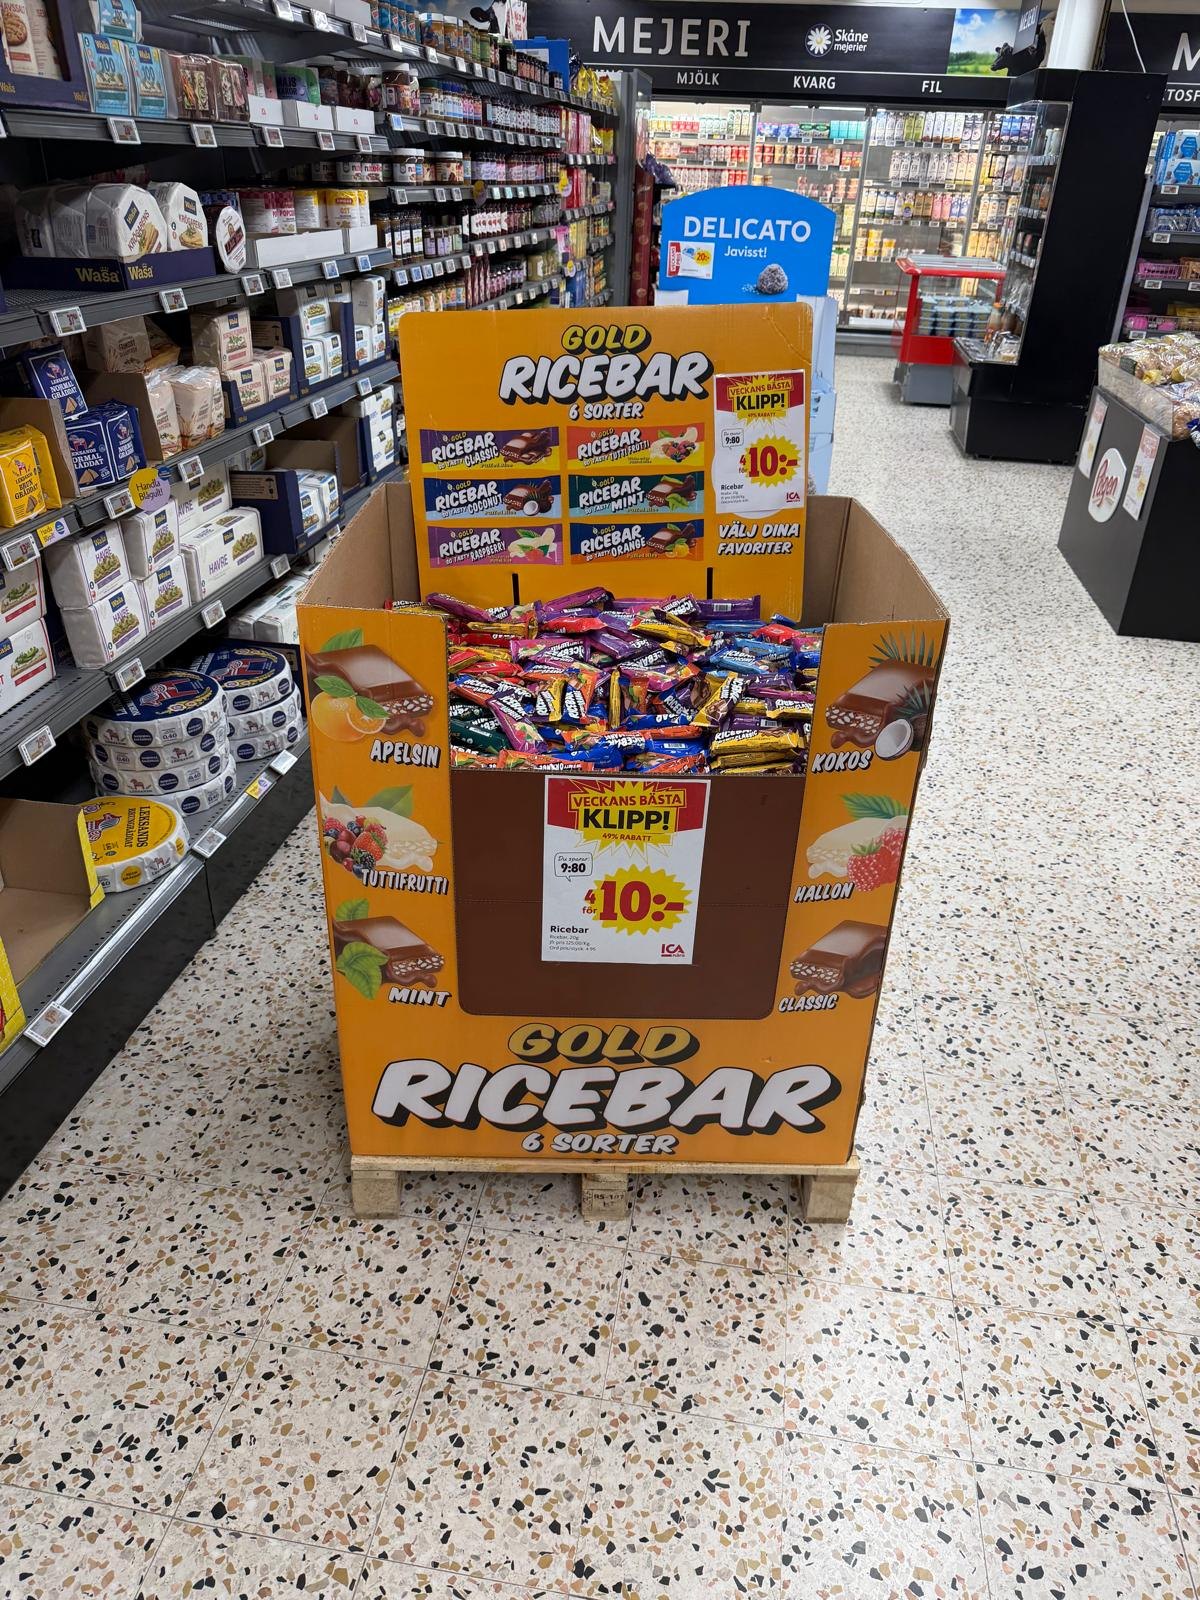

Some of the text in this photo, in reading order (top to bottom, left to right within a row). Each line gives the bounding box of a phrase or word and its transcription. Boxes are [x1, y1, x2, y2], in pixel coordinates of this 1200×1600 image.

[593, 16, 751, 57] MEJERI
[834, 29, 869, 43] Skåne
[833, 42, 868, 53] mejerier
[99, 56, 116, 72] 100
[676, 70, 720, 86] MJÖLK
[793, 76, 837, 90] KVARG
[921, 80, 943, 94] FIL
[683, 216, 812, 243] DELICATO
[723, 245, 769, 259] Javisst!
[75, 267, 120, 284] Wasa
[128, 264, 154, 281] Wasa
[561, 323, 652, 355] GOLD
[49, 381, 75, 393] NORMAL
[50, 376, 70, 385] LEKSANDS
[498, 351, 715, 405] RICEBAR
[51, 387, 77, 400] GRÄDDAT
[729, 380, 792, 396] VECKANS BÄSTA
[568, 402, 645, 421] 6 SORTER
[735, 393, 786, 412] KLIPP!
[431, 431, 497, 463] RICEBAR
[577, 428, 641, 461] RICEBAR
[725, 436, 741, 445] 9:80
[72, 453, 102, 465] ORMAL
[464, 446, 500, 467] CLASSIC
[609, 450, 629, 462] TUTTI
[628, 440, 650, 454] FRUTTI
[739, 454, 747, 466] 4
[748, 445, 798, 478] 10:-
[14, 485, 39, 500] GRÄDDAT
[19, 480, 33, 491] BRUN
[136, 480, 161, 492] Handla
[578, 476, 642, 508] RICEBAR
[435, 480, 500, 512] RICEBAR
[467, 494, 505, 515] COCONUT
[610, 490, 646, 512] MINT
[786, 492, 801, 501] ICA
[178, 500, 194, 518] AVRE
[718, 521, 801, 539] VÄLJ DINA
[438, 528, 502, 558] RICEBAR
[580, 524, 643, 555] RICEBAR
[611, 537, 647, 557] ORANGE
[717, 541, 793, 556] FAVORITER
[95, 546, 112, 562] HAVRE
[469, 541, 506, 562] RASPBERRY
[208, 554, 229, 574] HAVRE
[158, 580, 175, 594] HAVRE
[112, 607, 129, 622] HAVRE
[370, 738, 442, 768] APELSIN
[811, 749, 874, 773] KOKOS
[573, 792, 682, 808] VECKANS BÄSTA
[136, 806, 151, 848] LEKSANDS
[583, 808, 671, 831] KLIPP!
[619, 834, 652, 842] RABATT
[560, 862, 586, 873] 9:80
[361, 868, 449, 895] TUTTIFRUTTI
[584, 889, 596, 905] 4
[599, 880, 684, 922] 10:-
[793, 882, 857, 903] HALLON
[582, 906, 598, 915] för
[550, 925, 589, 934] Ricebar
[661, 943, 685, 954] ICA
[388, 986, 453, 1007] MINT
[778, 994, 839, 1014] CLASSIC
[508, 1022, 700, 1065] GOLD
[371, 1058, 842, 1136] RICEBAR
[521, 1132, 679, 1155] 6 SORTER
